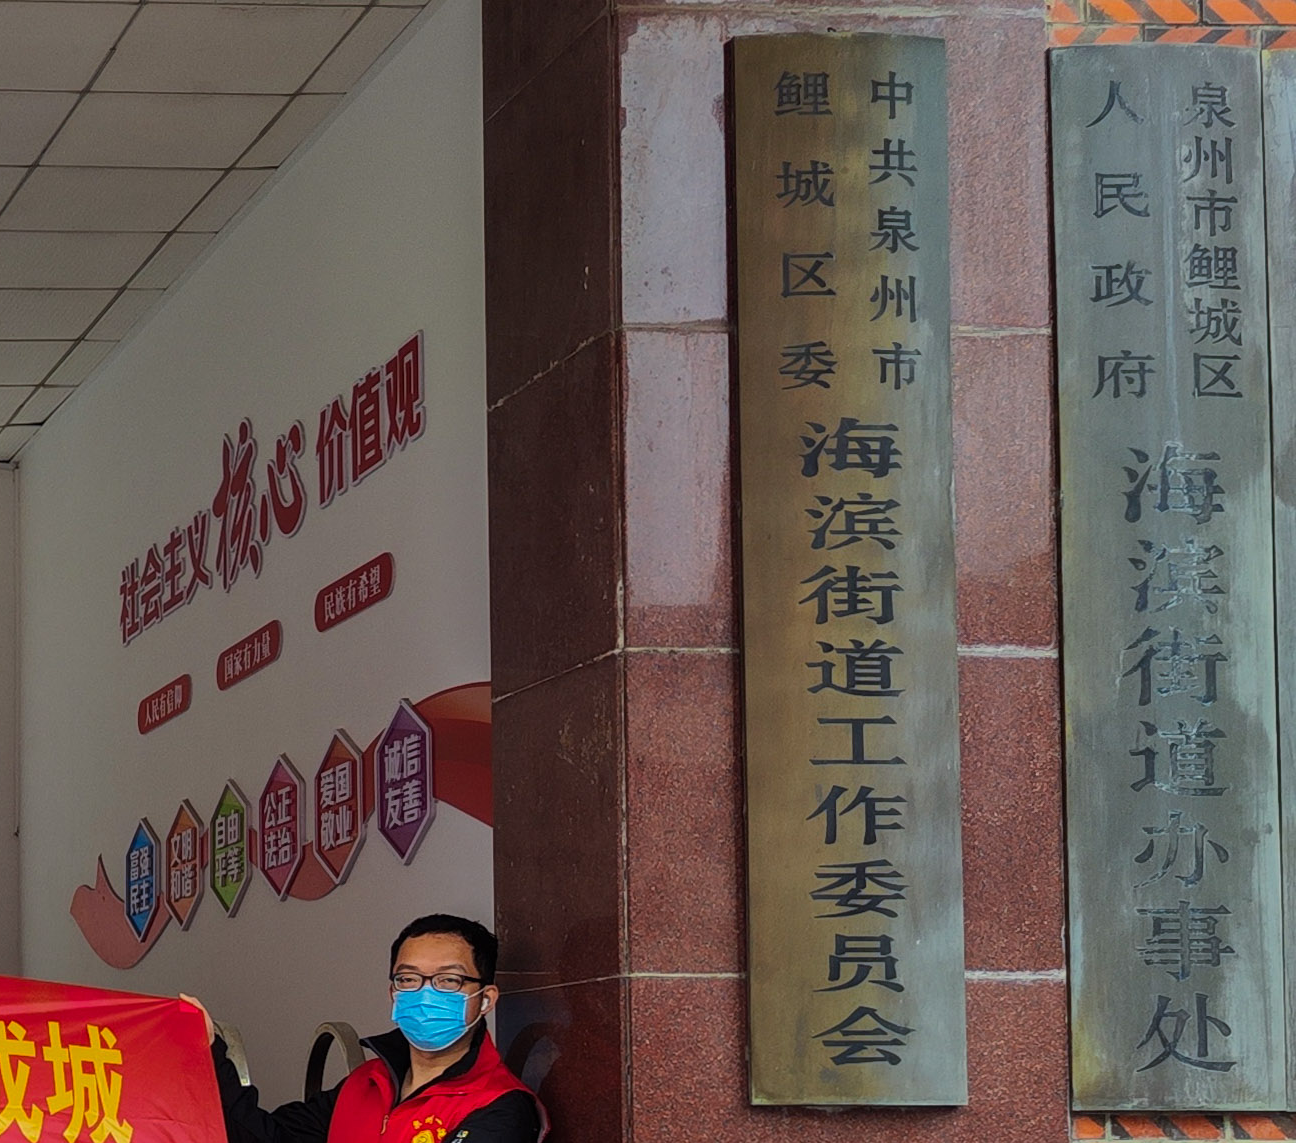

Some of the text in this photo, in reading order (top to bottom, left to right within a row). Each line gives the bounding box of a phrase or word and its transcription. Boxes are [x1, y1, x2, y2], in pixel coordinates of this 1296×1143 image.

[773, 70, 839, 391] 鲤城区委
[868, 71, 922, 391] 中共泉州市
[1085, 80, 1156, 399] 人民政府
[1182, 81, 1243, 399] 泉州市鲤城区
[324, 564, 382, 623] 民族有希望
[224, 631, 271, 683] 国家有力量
[144, 684, 183, 727] 人民有信仰
[384, 734, 421, 784] 诚信
[798, 417, 916, 1066] 海滨街道工作委员会
[1120, 445, 1238, 1074] 海滨街道办事处
[264, 785, 293, 829] 公正
[320, 760, 352, 809] 爱国
[384, 779, 422, 830] 友善
[170, 828, 193, 868] 文明
[215, 809, 241, 847] 自由
[264, 830, 293, 871] 法治
[320, 805, 353, 851] 敬业
[170, 865, 193, 901] 和谐
[214, 847, 242, 887] 平等
[130, 877, 150, 915] 民主
